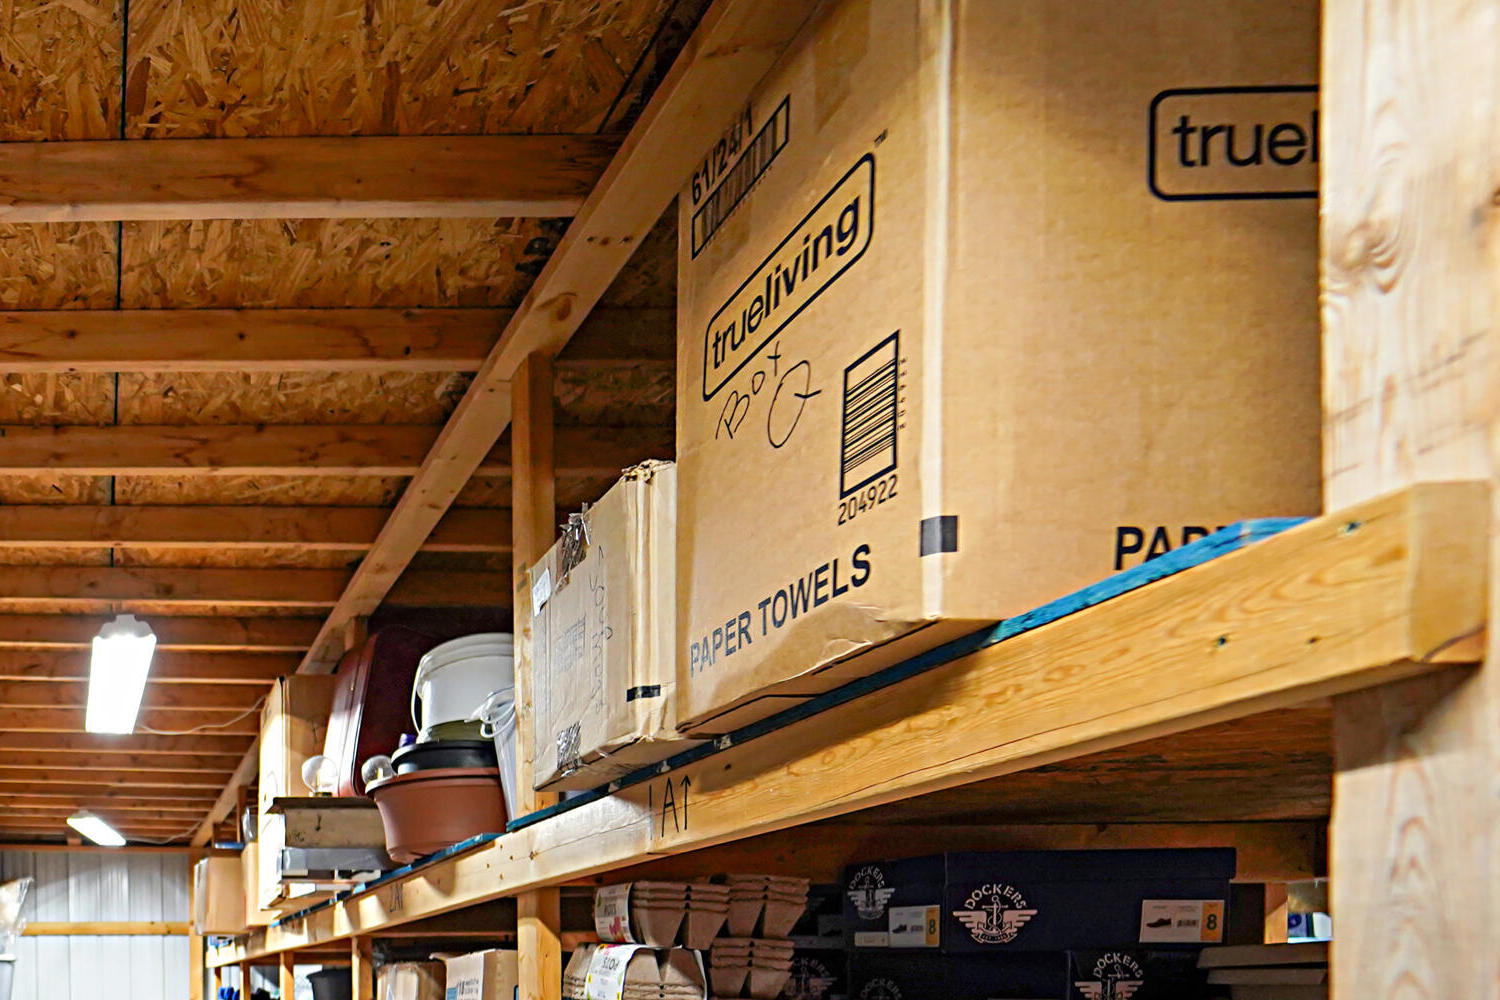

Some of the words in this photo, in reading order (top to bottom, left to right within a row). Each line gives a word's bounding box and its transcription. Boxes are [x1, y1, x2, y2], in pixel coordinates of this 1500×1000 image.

[712, 195, 861, 370] trueliving
[837, 474, 898, 526] 204922
[690, 610, 752, 678] PAPER
[758, 544, 871, 636] TOWELS
[850, 866, 887, 890] DOCKERS
[964, 883, 1028, 911] DOCKERS
[928, 918, 936, 936] 8
[1205, 913, 1218, 931] 8
[603, 957, 621, 972] POTS
[1093, 952, 1144, 979] DOCKERS
